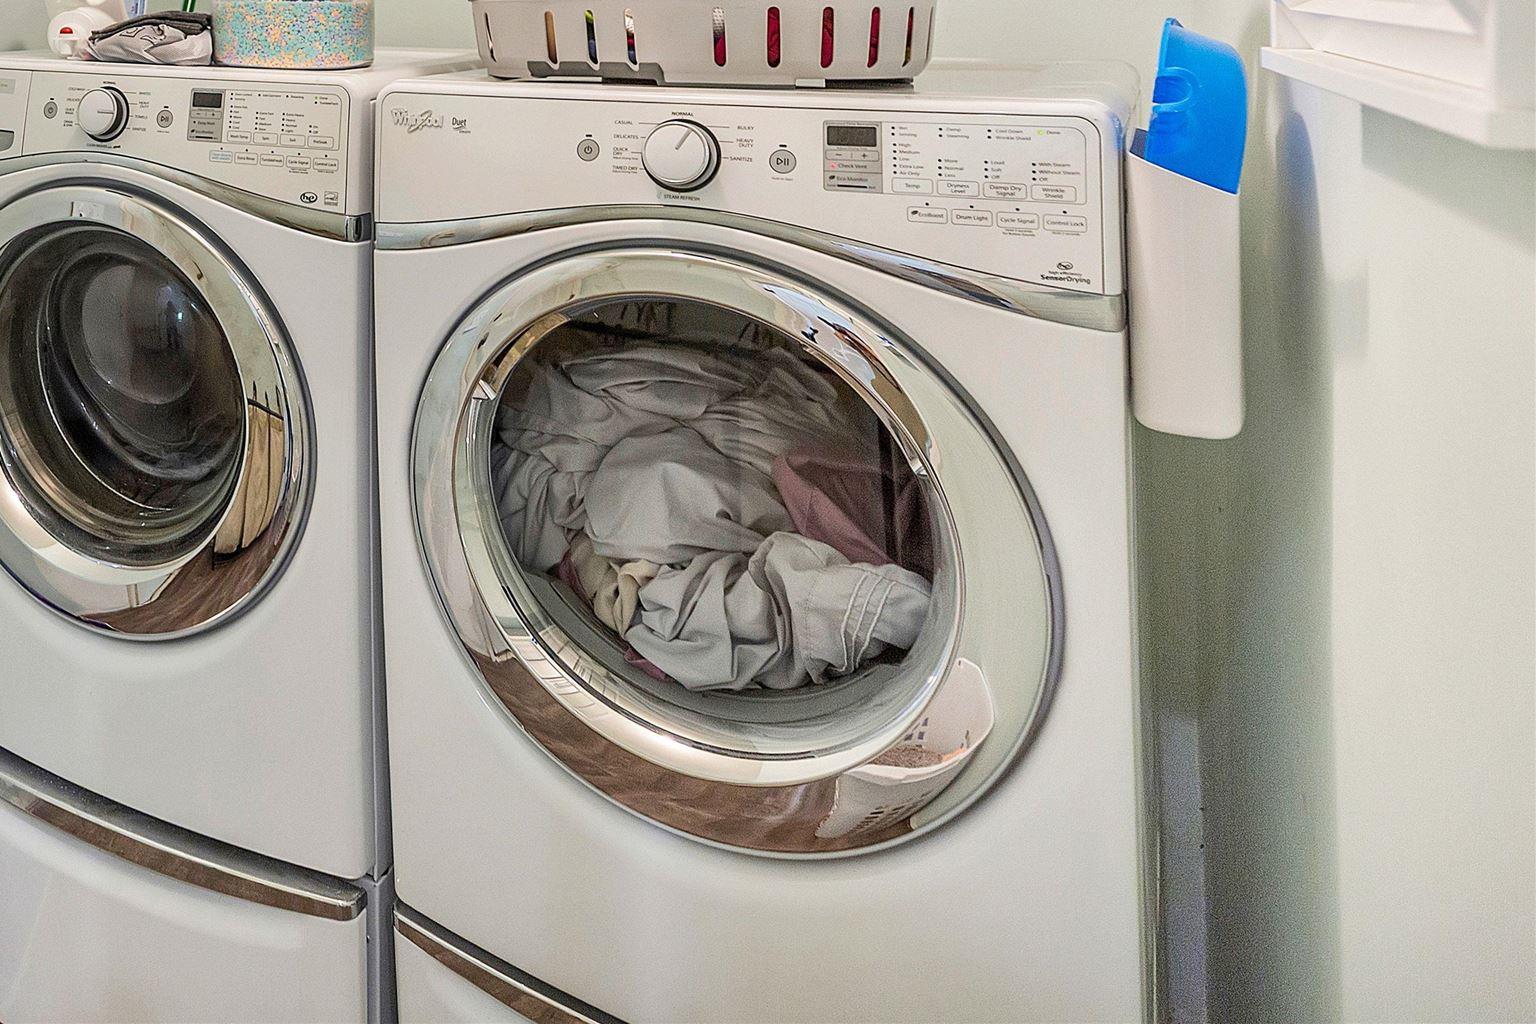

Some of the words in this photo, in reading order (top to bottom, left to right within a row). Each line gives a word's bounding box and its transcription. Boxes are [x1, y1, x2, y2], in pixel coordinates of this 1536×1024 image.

[451, 117, 467, 127] Duet
[989, 184, 1010, 192] Damp
[1010, 185, 1022, 193] Dry
[996, 190, 1016, 198] Signal
[972, 214, 989, 222] Light
[999, 217, 1016, 225] Cycle
[1016, 218, 1035, 226] Signal
[1040, 273, 1091, 284] SensorDrying
